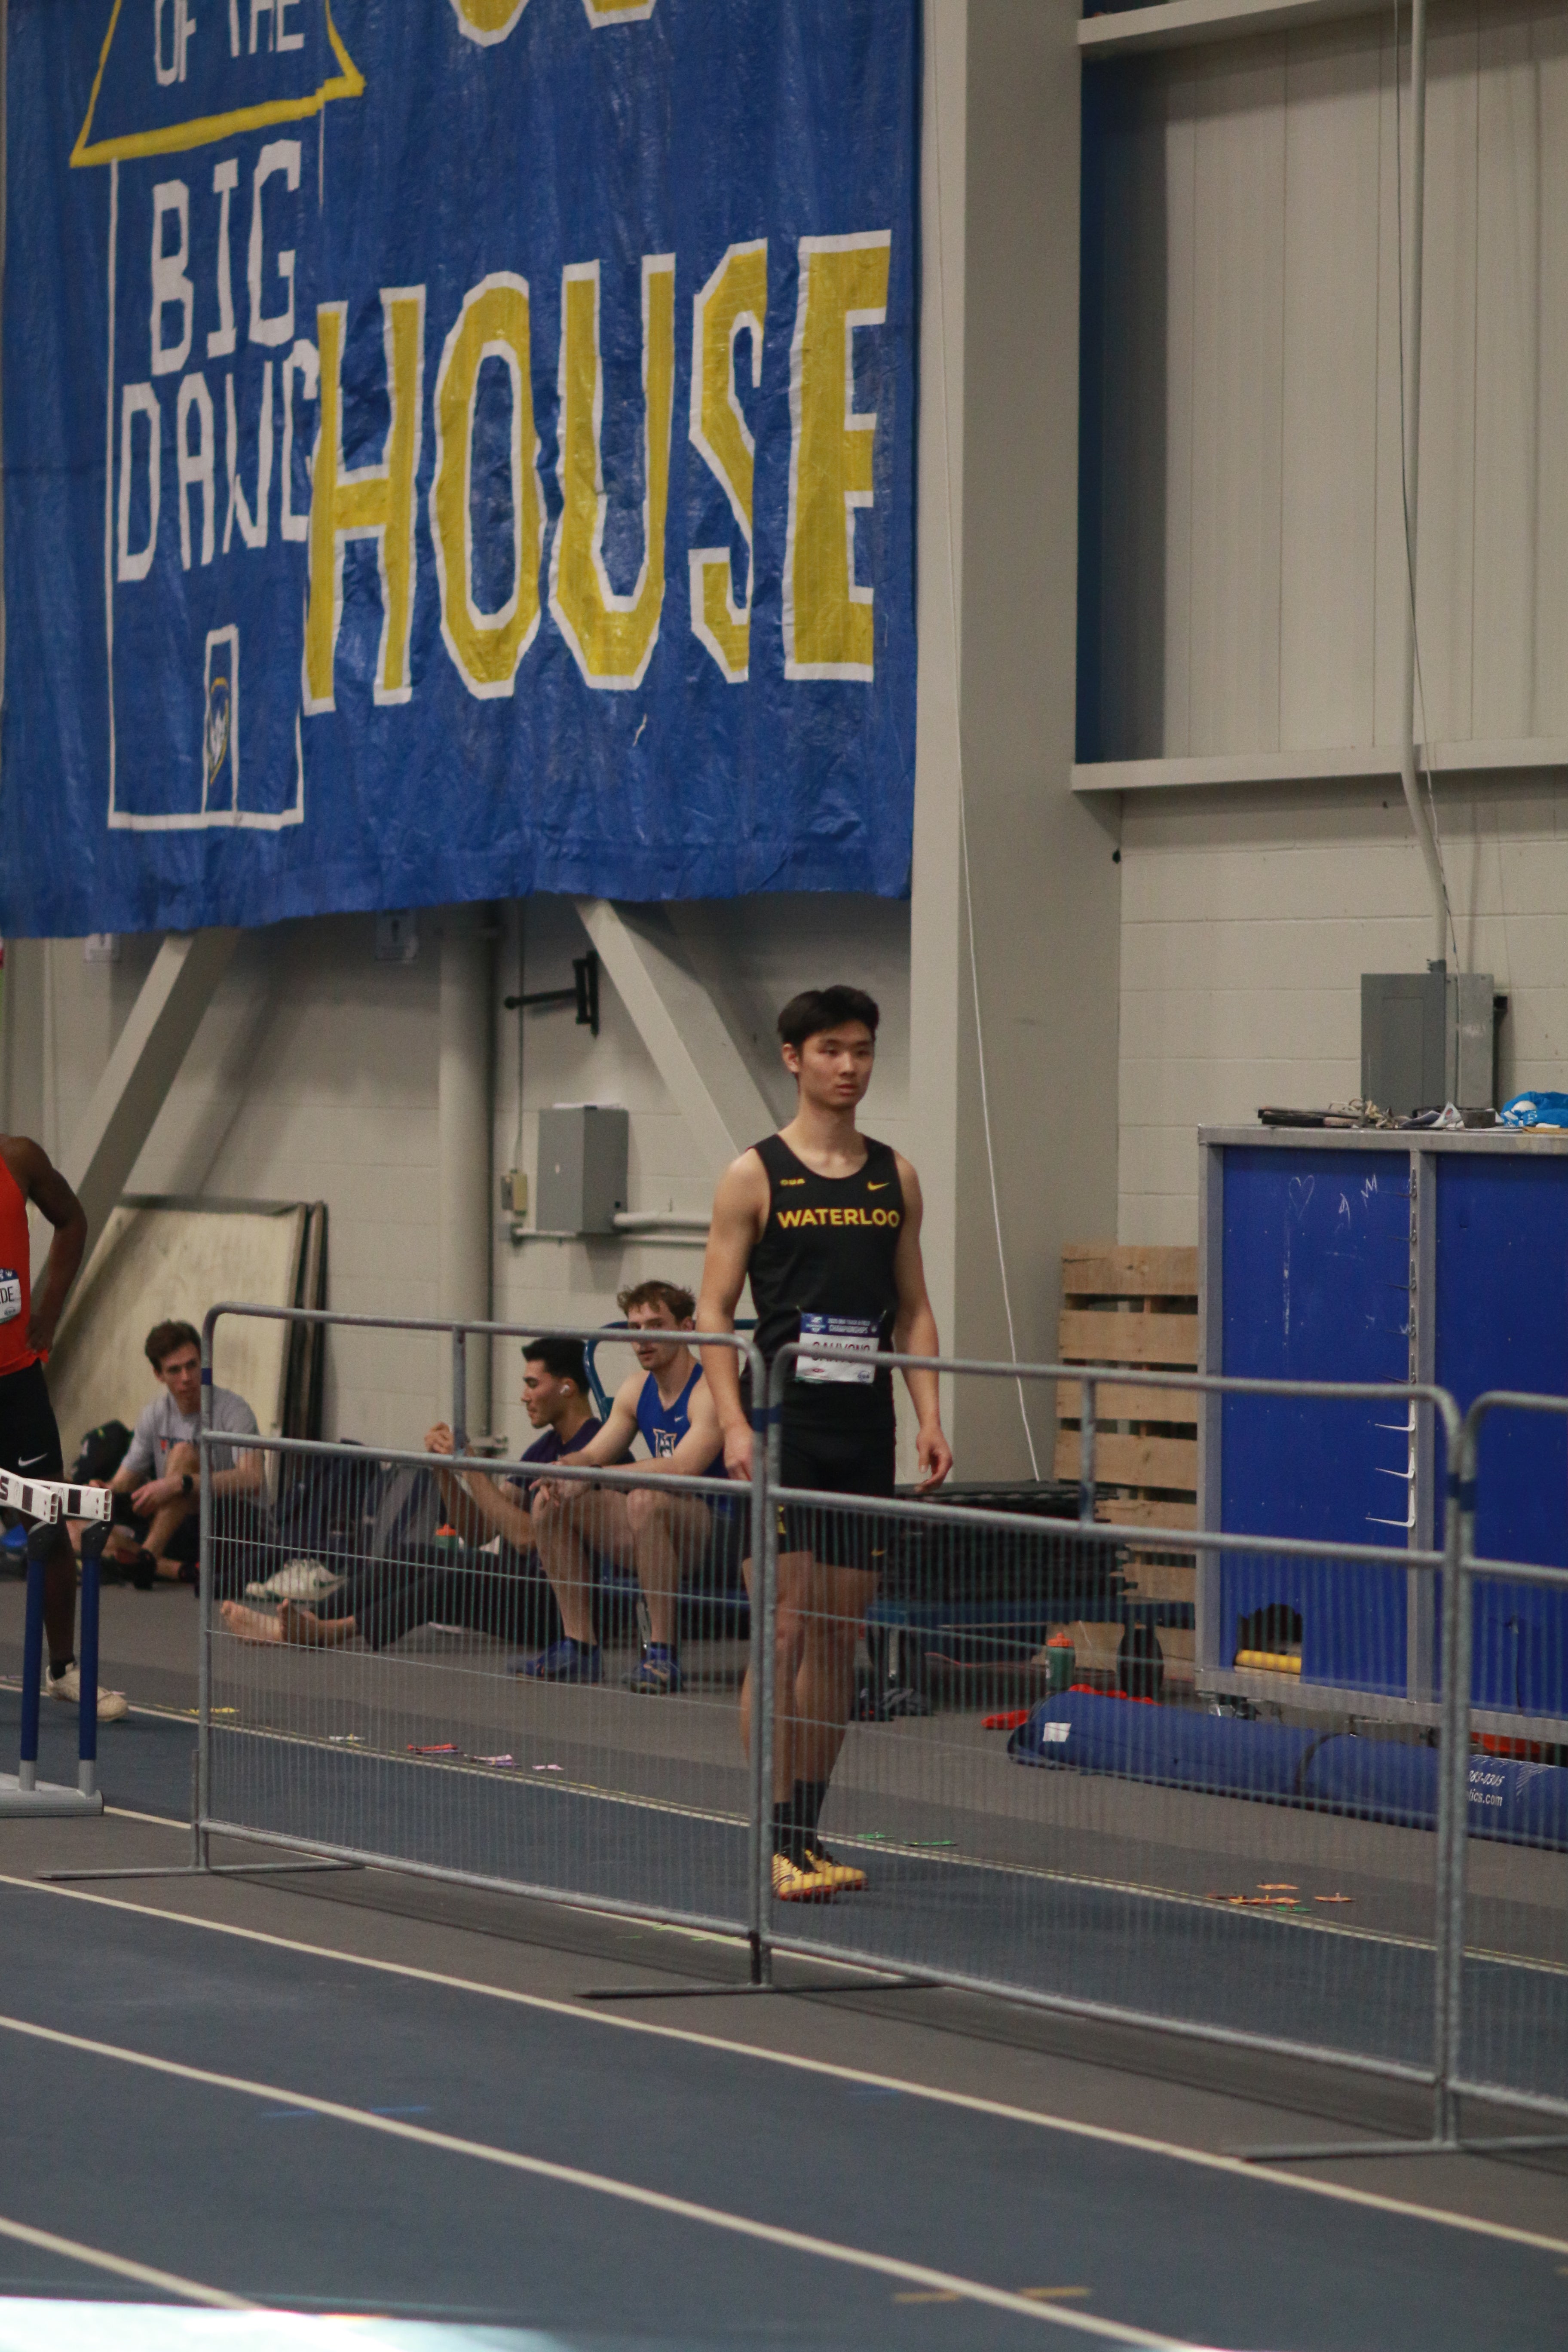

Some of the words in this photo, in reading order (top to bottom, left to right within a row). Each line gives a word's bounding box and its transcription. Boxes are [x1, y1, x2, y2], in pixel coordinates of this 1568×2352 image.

[150, 139, 301, 376] BIG
[301, 230, 891, 716] HOUSE
[777, 1208, 900, 1228] WATERLOO
[0, 1286, 14, 1304] DE
[1469, 1788, 1503, 1807] tics.com
